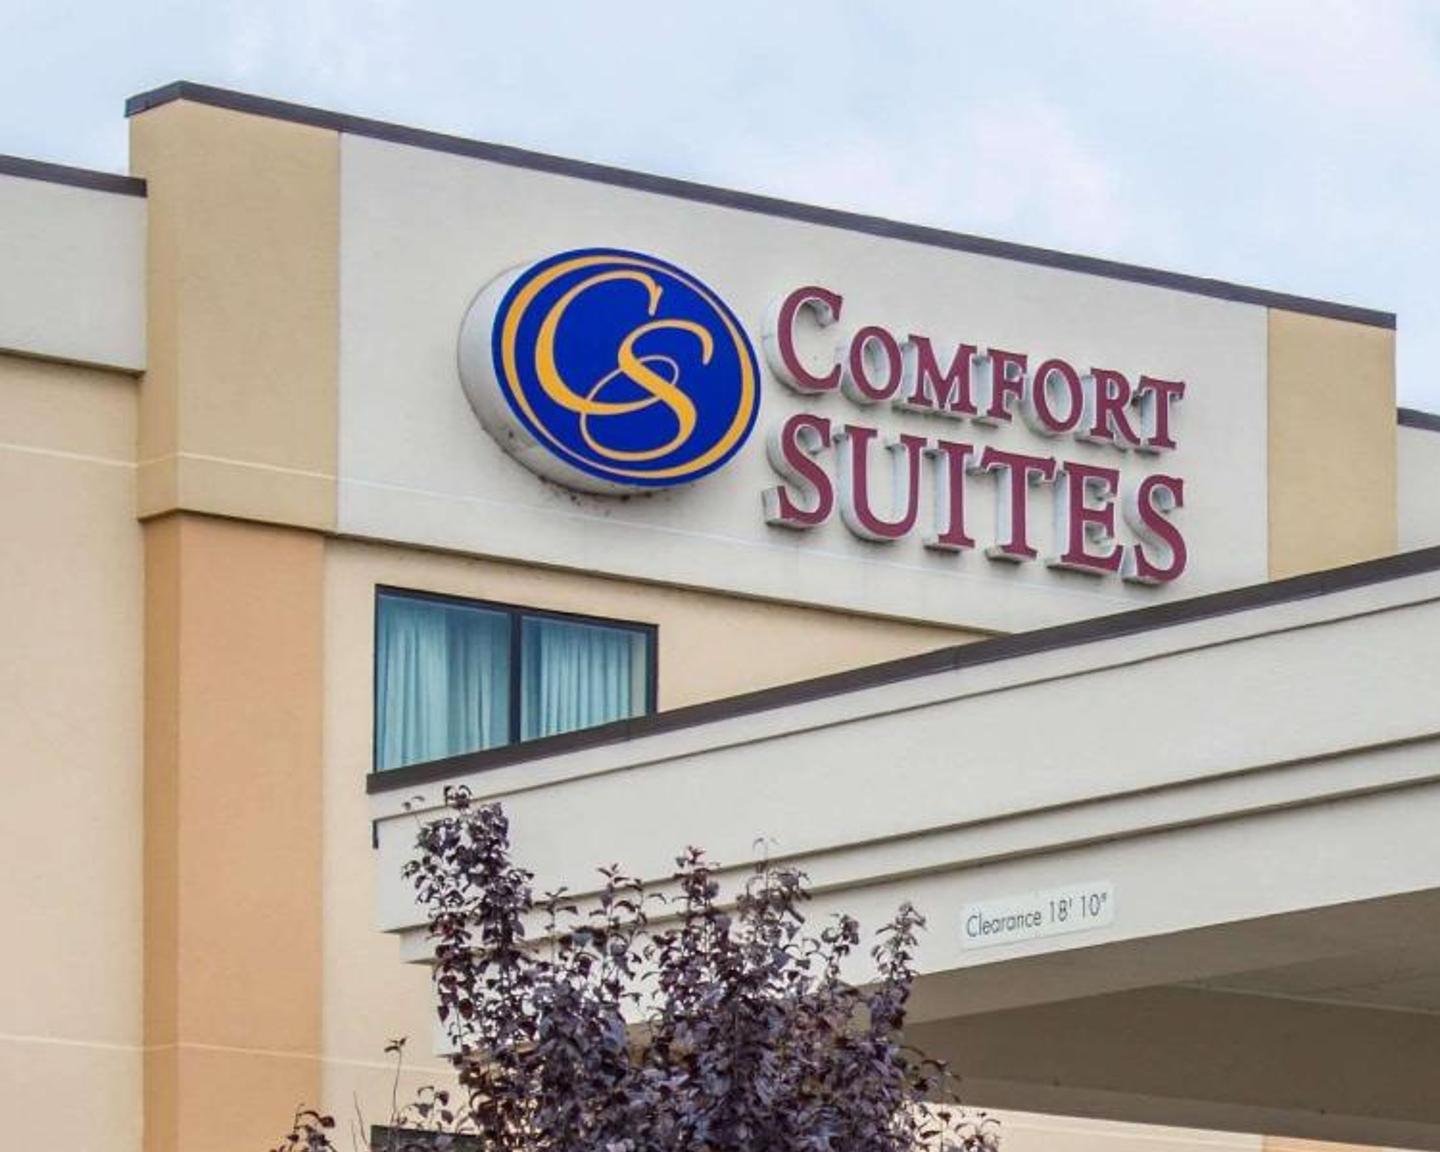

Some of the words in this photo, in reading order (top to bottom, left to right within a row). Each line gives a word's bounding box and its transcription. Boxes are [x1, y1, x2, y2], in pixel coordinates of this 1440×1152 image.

[776, 286, 1186, 449] COMFORT
[776, 415, 1187, 583] SUITES
[966, 910, 1042, 938] Clearance
[1049, 898, 1073, 923] 18'
